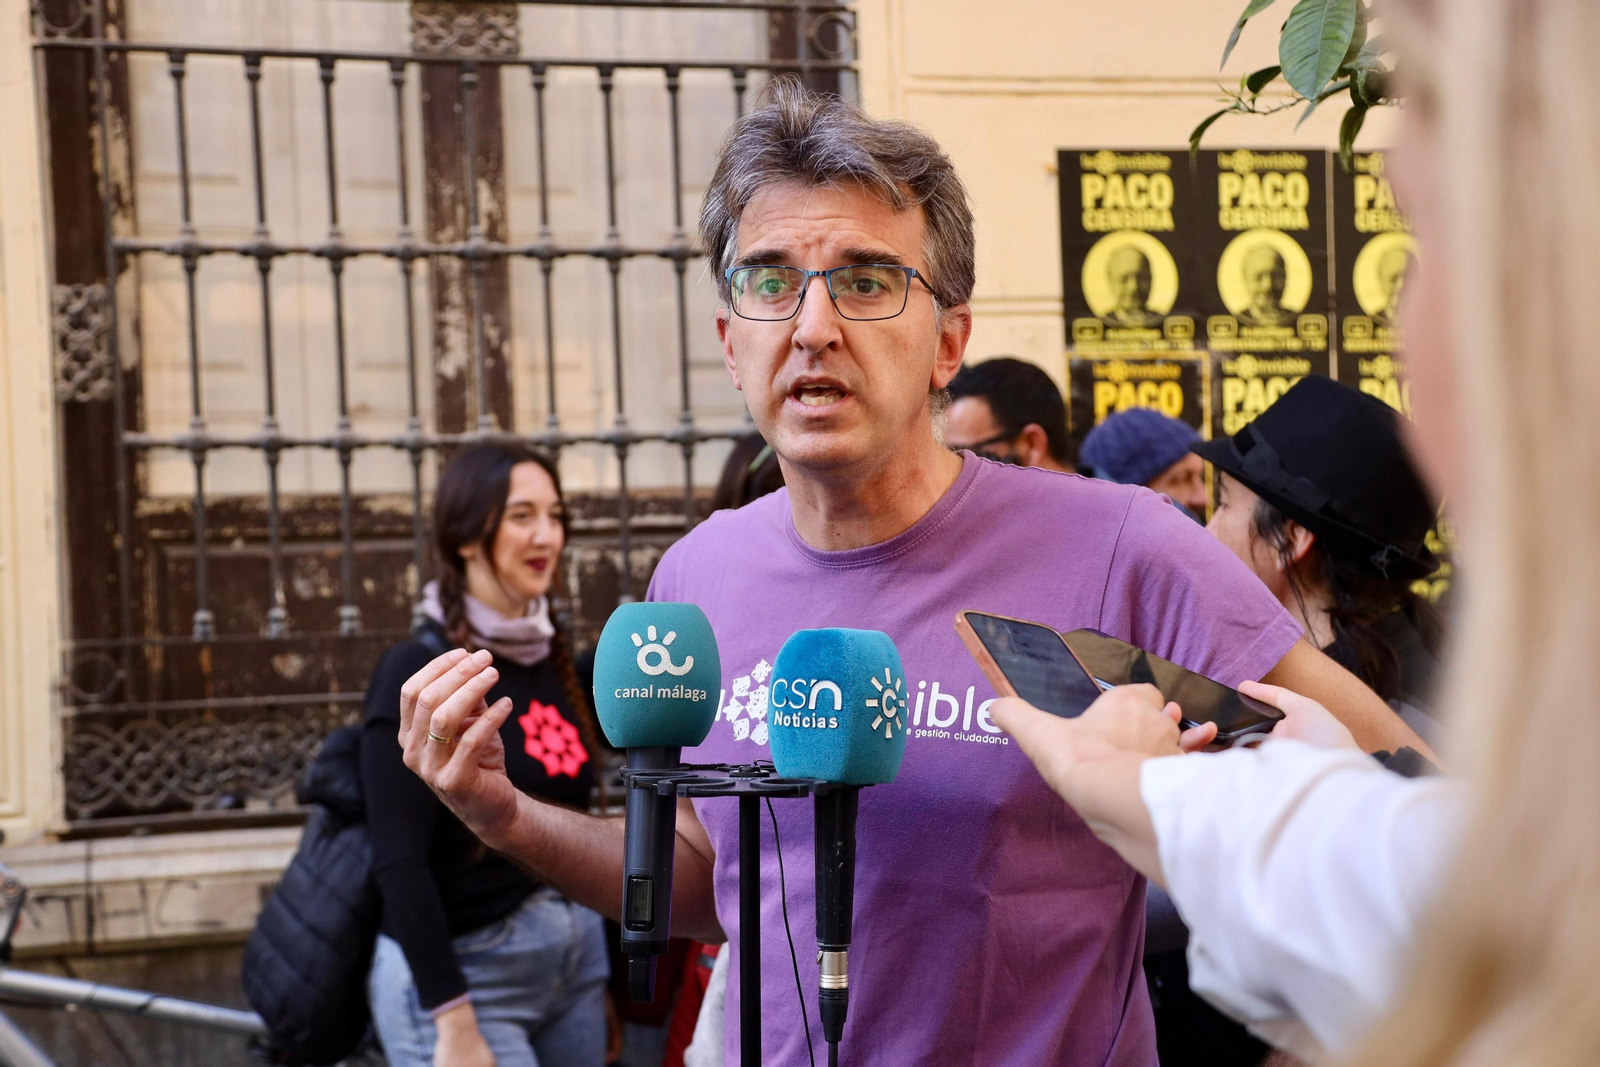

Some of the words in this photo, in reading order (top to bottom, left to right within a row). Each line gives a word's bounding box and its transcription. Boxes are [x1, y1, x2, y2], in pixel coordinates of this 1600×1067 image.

[1081, 173, 1174, 208] PACO
[1218, 172, 1309, 207] PACO
[1354, 175, 1396, 209] PA
[1082, 208, 1175, 232] CENSURA
[1218, 207, 1310, 231] CENSURA
[1093, 381, 1184, 419] PACO
[615, 684, 653, 699] canal
[657, 685, 707, 702] málaga
[906, 680, 1004, 734] ible
[773, 711, 839, 729] Noticias
[915, 728, 950, 739] gestión
[954, 731, 1009, 746] ciudadana
